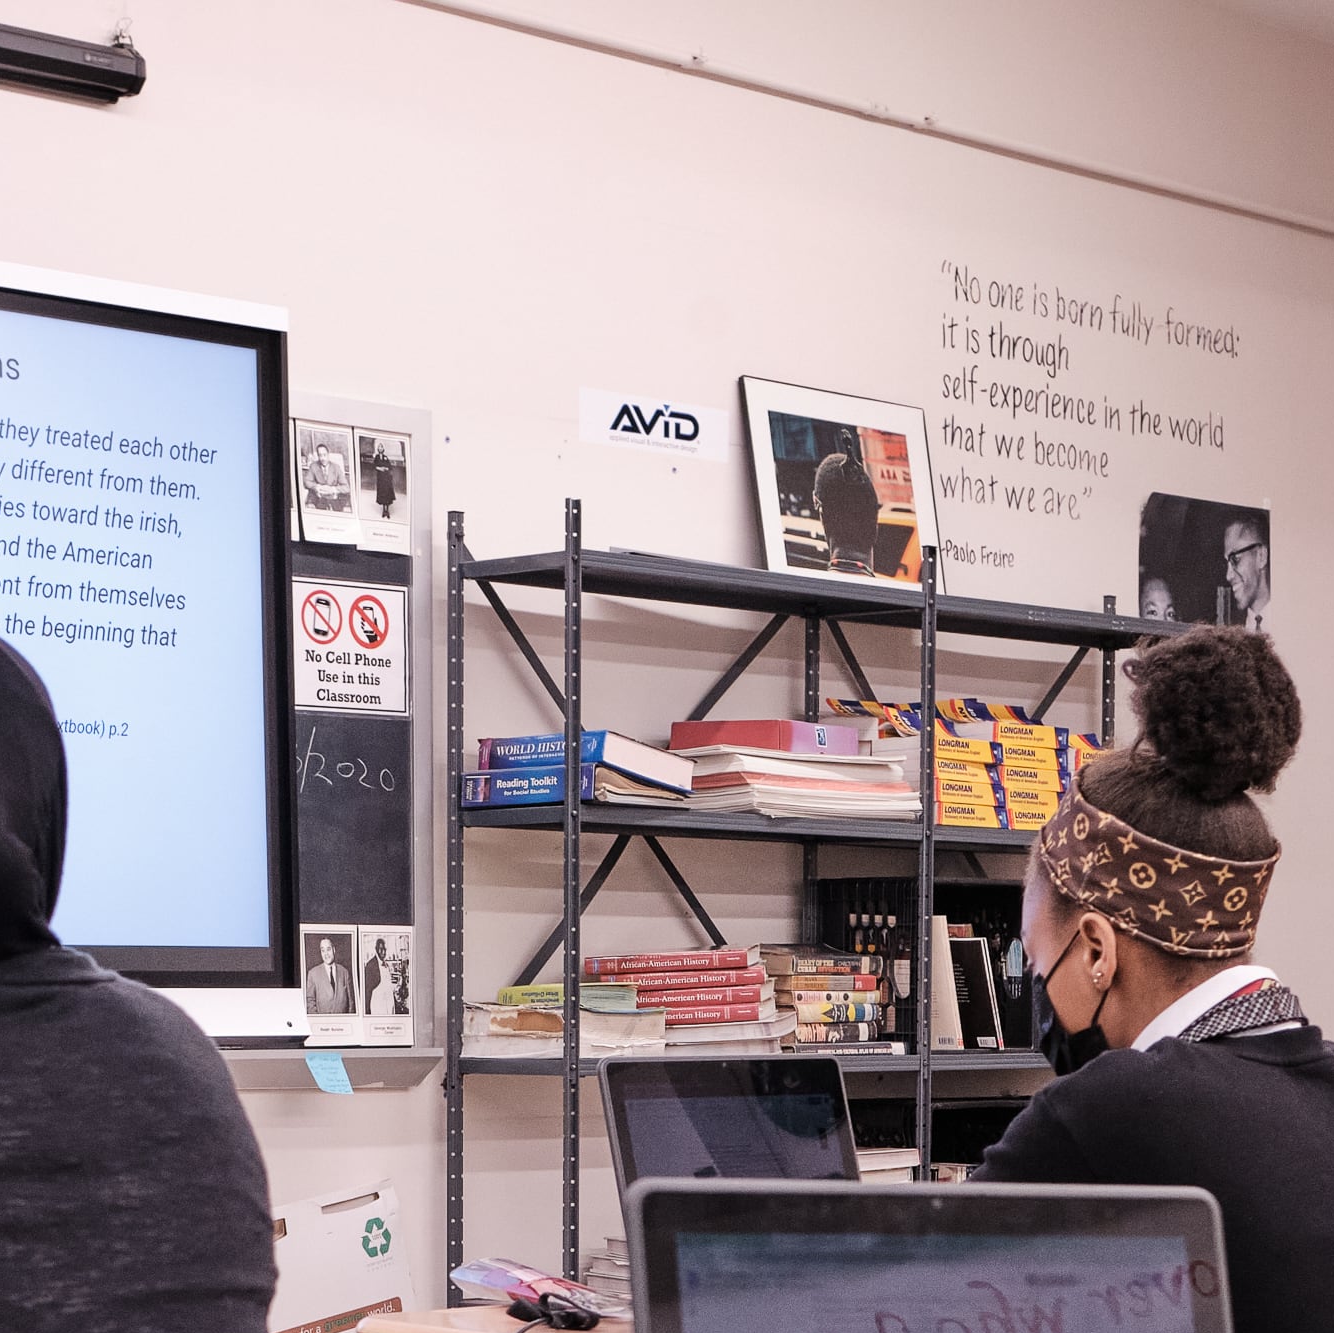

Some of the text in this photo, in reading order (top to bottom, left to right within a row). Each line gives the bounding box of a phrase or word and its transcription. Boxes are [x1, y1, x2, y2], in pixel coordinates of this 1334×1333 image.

[989, 281, 1023, 311] one
[1033, 283, 1048, 318] is
[1056, 287, 1103, 331] born
[943, 313, 1068, 378] it is through
[943, 365, 1223, 451] self-experience in the world
[0, 418, 40, 447] they
[46, 425, 113, 451] treated
[120, 437, 163, 458] each
[170, 441, 217, 464] other
[942, 415, 1108, 477] that we become
[940, 467, 998, 503] what
[1005, 486, 1035, 512] we
[27, 537, 56, 560] the
[62, 542, 152, 569] American
[981, 546, 1014, 568] Freire
[305, 649, 391, 667] No Cell Phone
[318, 669, 380, 685] Use in this
[317, 689, 381, 704] Classroom
[56, 718, 128, 739] xtbook) p.2
[1000, 726, 1033, 736] LONGMAN
[497, 743, 535, 756] WORLD
[938, 739, 969, 749] LONGMAN
[1005, 748, 1035, 757] LONGMAN
[937, 761, 967, 771] LONGMAN
[1007, 769, 1038, 778] LONGMAN
[497, 776, 558, 789] Reading Toolkit
[942, 783, 972, 792] LONGMAN
[1010, 791, 1038, 800] LONGMAN
[945, 806, 975, 815] LONGMAN
[1015, 812, 1046, 820] LONGMAN
[621, 956, 709, 969] African-American History
[638, 974, 726, 986] African-American History
[316, 1326, 321, 1333] a
